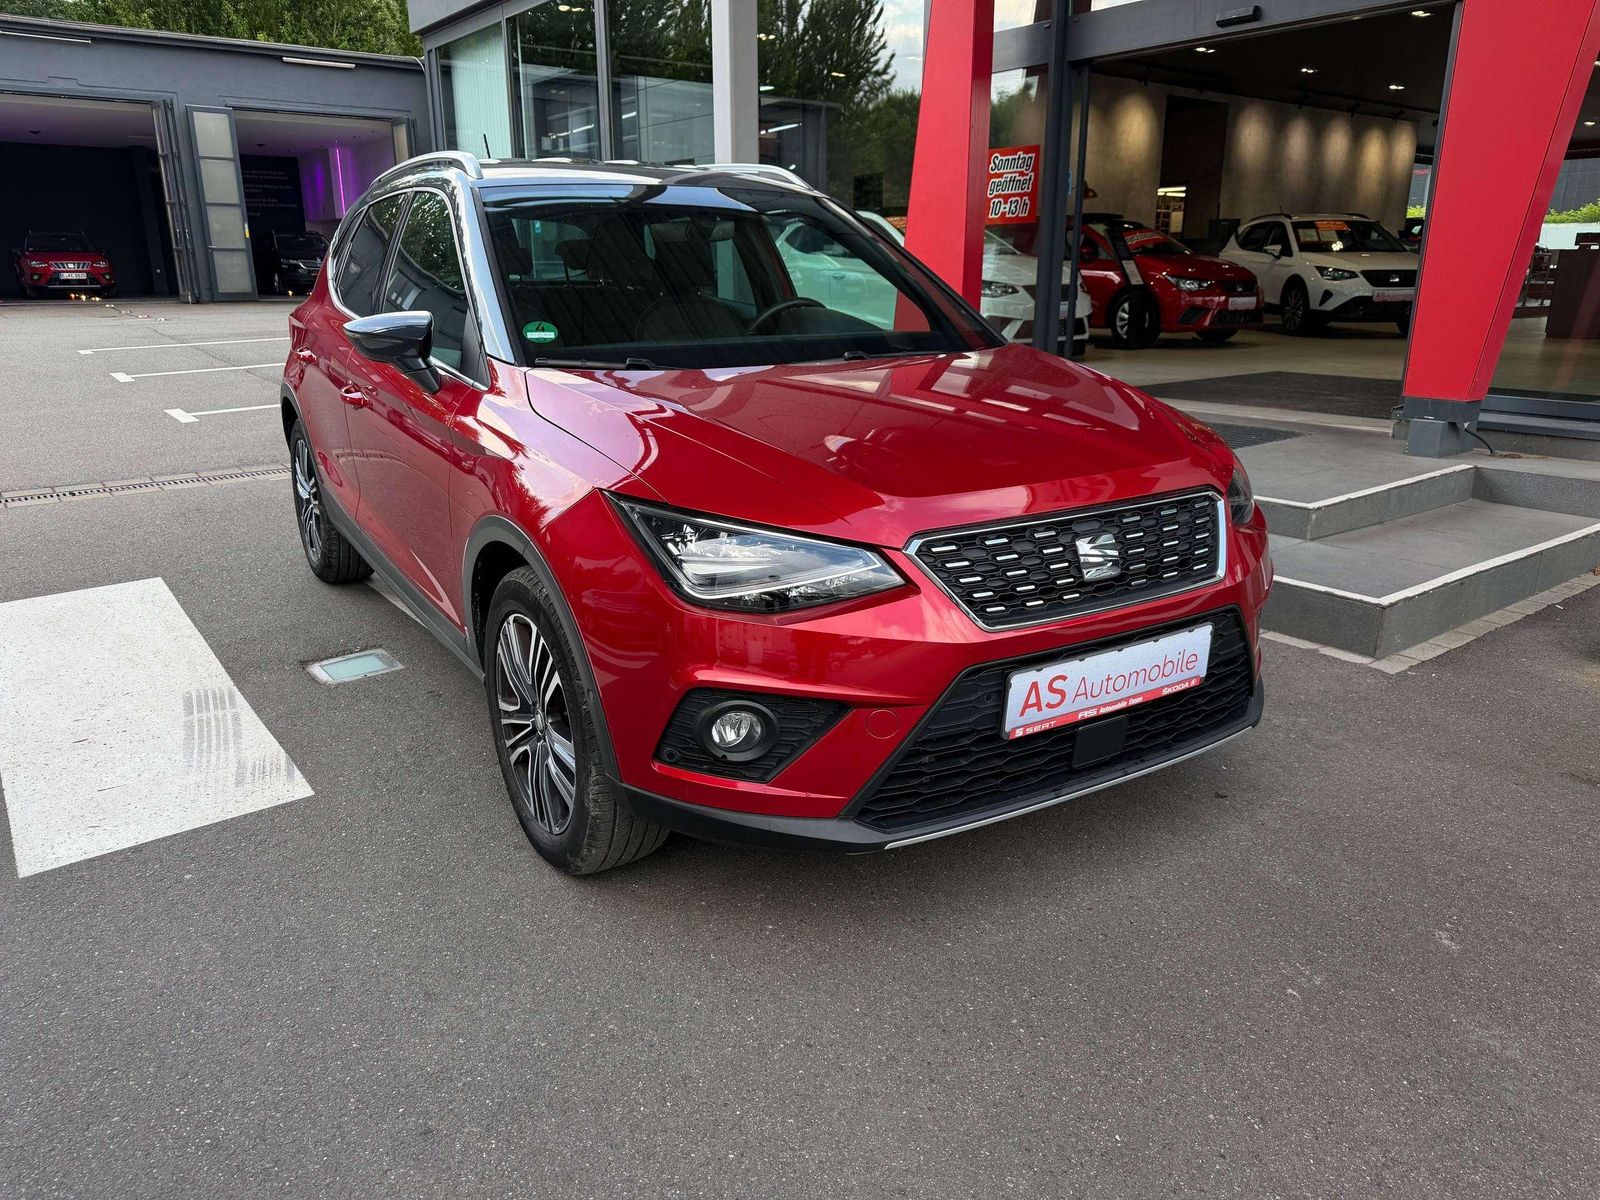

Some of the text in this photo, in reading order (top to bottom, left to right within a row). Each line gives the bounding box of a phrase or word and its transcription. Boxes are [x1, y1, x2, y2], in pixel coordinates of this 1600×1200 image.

[989, 152, 1035, 173] Sonntag
[988, 174, 1034, 197] geöffnet
[989, 196, 1030, 218] 10-13 h
[535, 320, 545, 332] 4
[1019, 649, 1198, 717] AS Automobile
[1099, 699, 1127, 714] Automobile
[1025, 719, 1057, 735] SEAT
